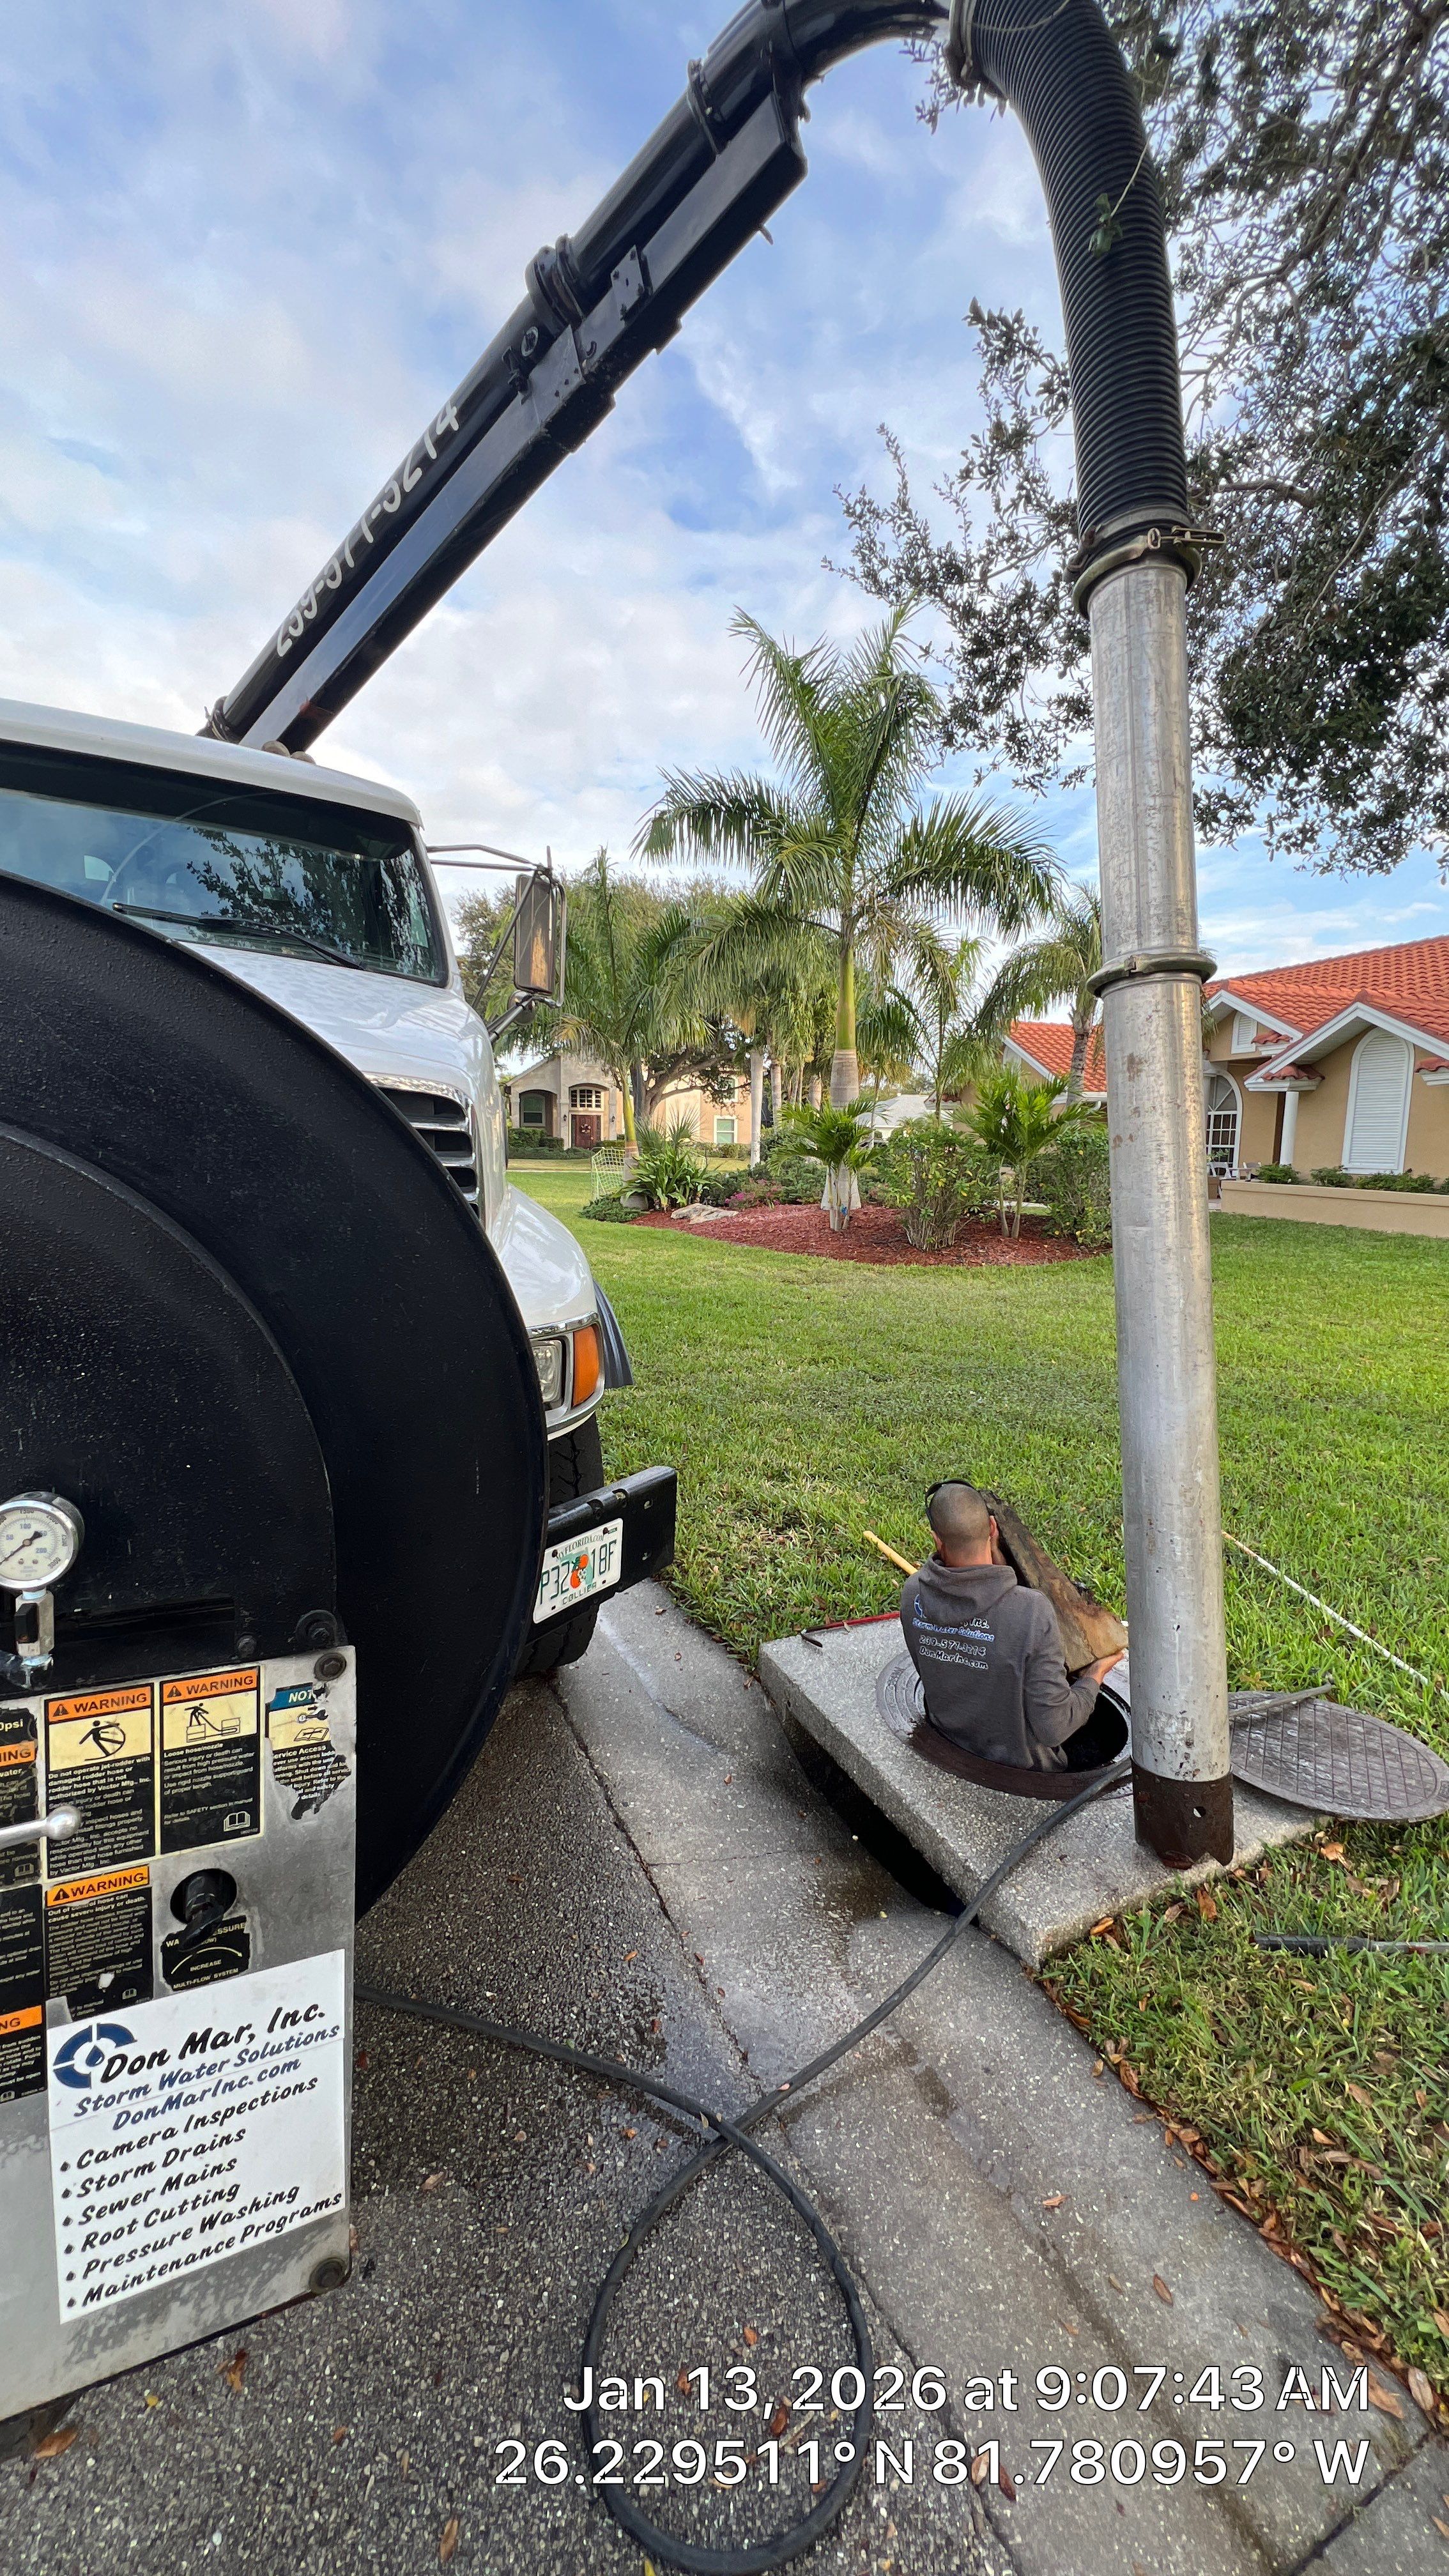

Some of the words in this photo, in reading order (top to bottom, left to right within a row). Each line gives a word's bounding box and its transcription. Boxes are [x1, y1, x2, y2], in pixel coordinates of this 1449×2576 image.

[591, 1539, 617, 1579] 18F
[562, 1582, 597, 1606] COLLIER
[970, 1618, 990, 1629] Inc.
[958, 1627, 995, 1642] Solutions
[919, 1646, 989, 1670] DonMarInc.com
[186, 1675, 254, 1696] WARNING
[74, 1693, 148, 1713] WARNING
[288, 1690, 314, 1703] NOT
[164, 1749, 184, 1758] Loose
[185, 1743, 224, 1754] hose/nozzle
[273, 1749, 298, 1759] ervice
[298, 1744, 326, 1755] Access
[73, 1765, 100, 1775] operate
[100, 1760, 135, 1770] jet-rodder
[164, 1758, 187, 1767] Serious
[188, 1754, 205, 1763] injury
[211, 1756, 238, 1765] pressure
[48, 1776, 82, 1786] damaged
[171, 1770, 192, 1781] impact
[178, 1778, 192, 1787] rigid
[192, 1774, 212, 1782] nozzle
[303, 1772, 323, 1780] before
[48, 1790, 87, 1800] authorized
[171, 1784, 192, 1794] proper
[186, 1807, 209, 1815] SAFETY
[117, 1816, 144, 1825] properly
[103, 1828, 128, 1836] accepts
[116, 1829, 150, 1841] equipment
[68, 1847, 98, 1857] operated
[114, 1844, 144, 1854] furnished
[70, 1873, 145, 1897] WARNING
[48, 1908, 62, 1917] Out
[97, 1896, 114, 1905] hose
[115, 1893, 128, 1901] can
[48, 1915, 70, 1923] cause
[70, 1910, 94, 1919] severe
[95, 1904, 115, 1914] injury
[125, 1896, 146, 1905] death.
[190, 1959, 222, 1972] INCREASE
[173, 1975, 212, 1989] MULTI-FLOW
[213, 1968, 239, 1979] SYSTEM
[100, 2046, 171, 2083] Don
[178, 2023, 257, 2060] Mar,
[266, 2003, 326, 2034] Inc.
[73, 2083, 152, 2117] Storm
[158, 2058, 231, 2092] Water
[233, 2023, 341, 2068] Solutions
[77, 2126, 179, 2170] Camera
[183, 2076, 319, 2133] Inspections
[76, 2160, 157, 2198] Storm
[162, 2127, 247, 2168] Drains
[78, 2188, 157, 2225] Sewer
[160, 2156, 238, 2196] Mains
[80, 2218, 139, 2253] Root
[143, 2182, 241, 2228] Cutting
[82, 2226, 195, 2280] Pressure
[198, 2185, 301, 2234] Washing
[82, 2238, 236, 2307] Maintenance
[239, 2191, 343, 2244] Programs
